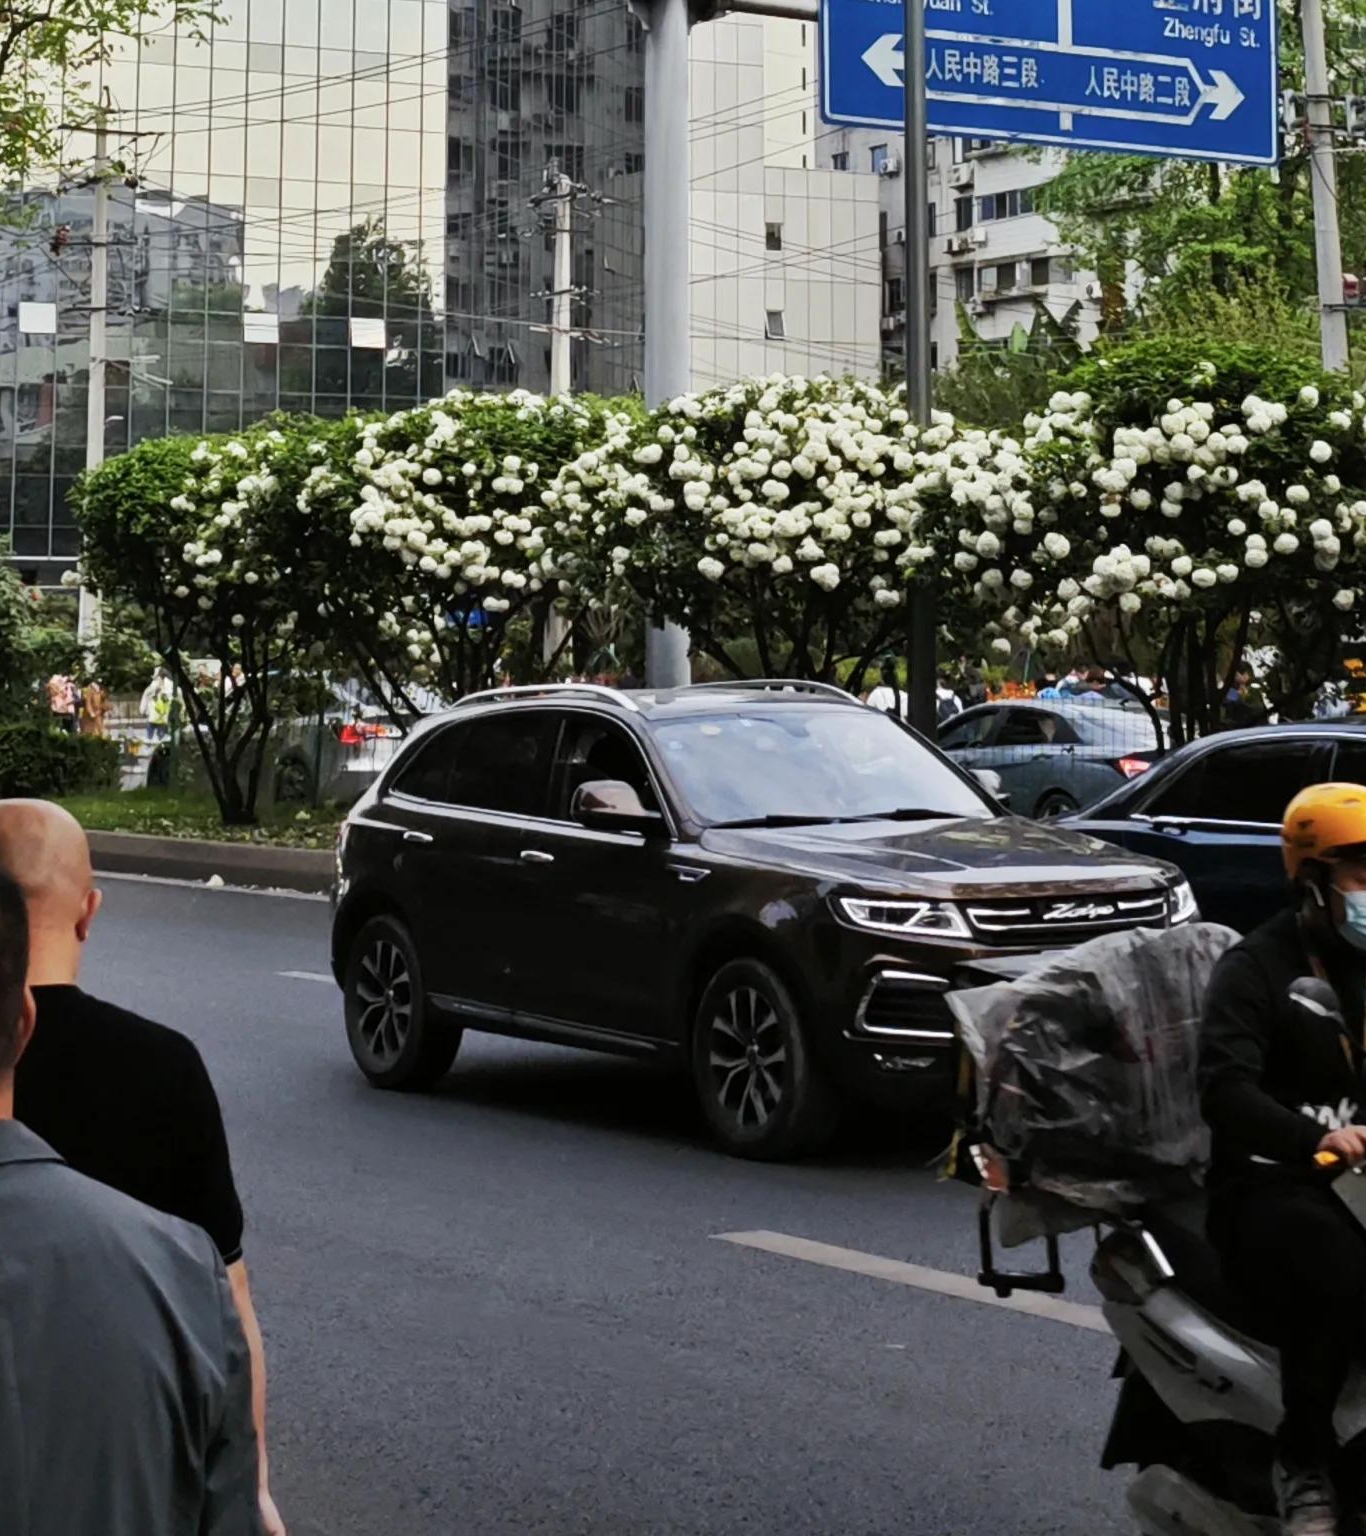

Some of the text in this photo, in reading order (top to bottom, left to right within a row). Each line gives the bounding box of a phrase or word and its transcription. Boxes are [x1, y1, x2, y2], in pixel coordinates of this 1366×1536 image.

[1163, 16, 1261, 48] Zhengfu St.
[925, 48, 1040, 89] 人民中路三段
[1085, 66, 1192, 108] 人民中路二段
